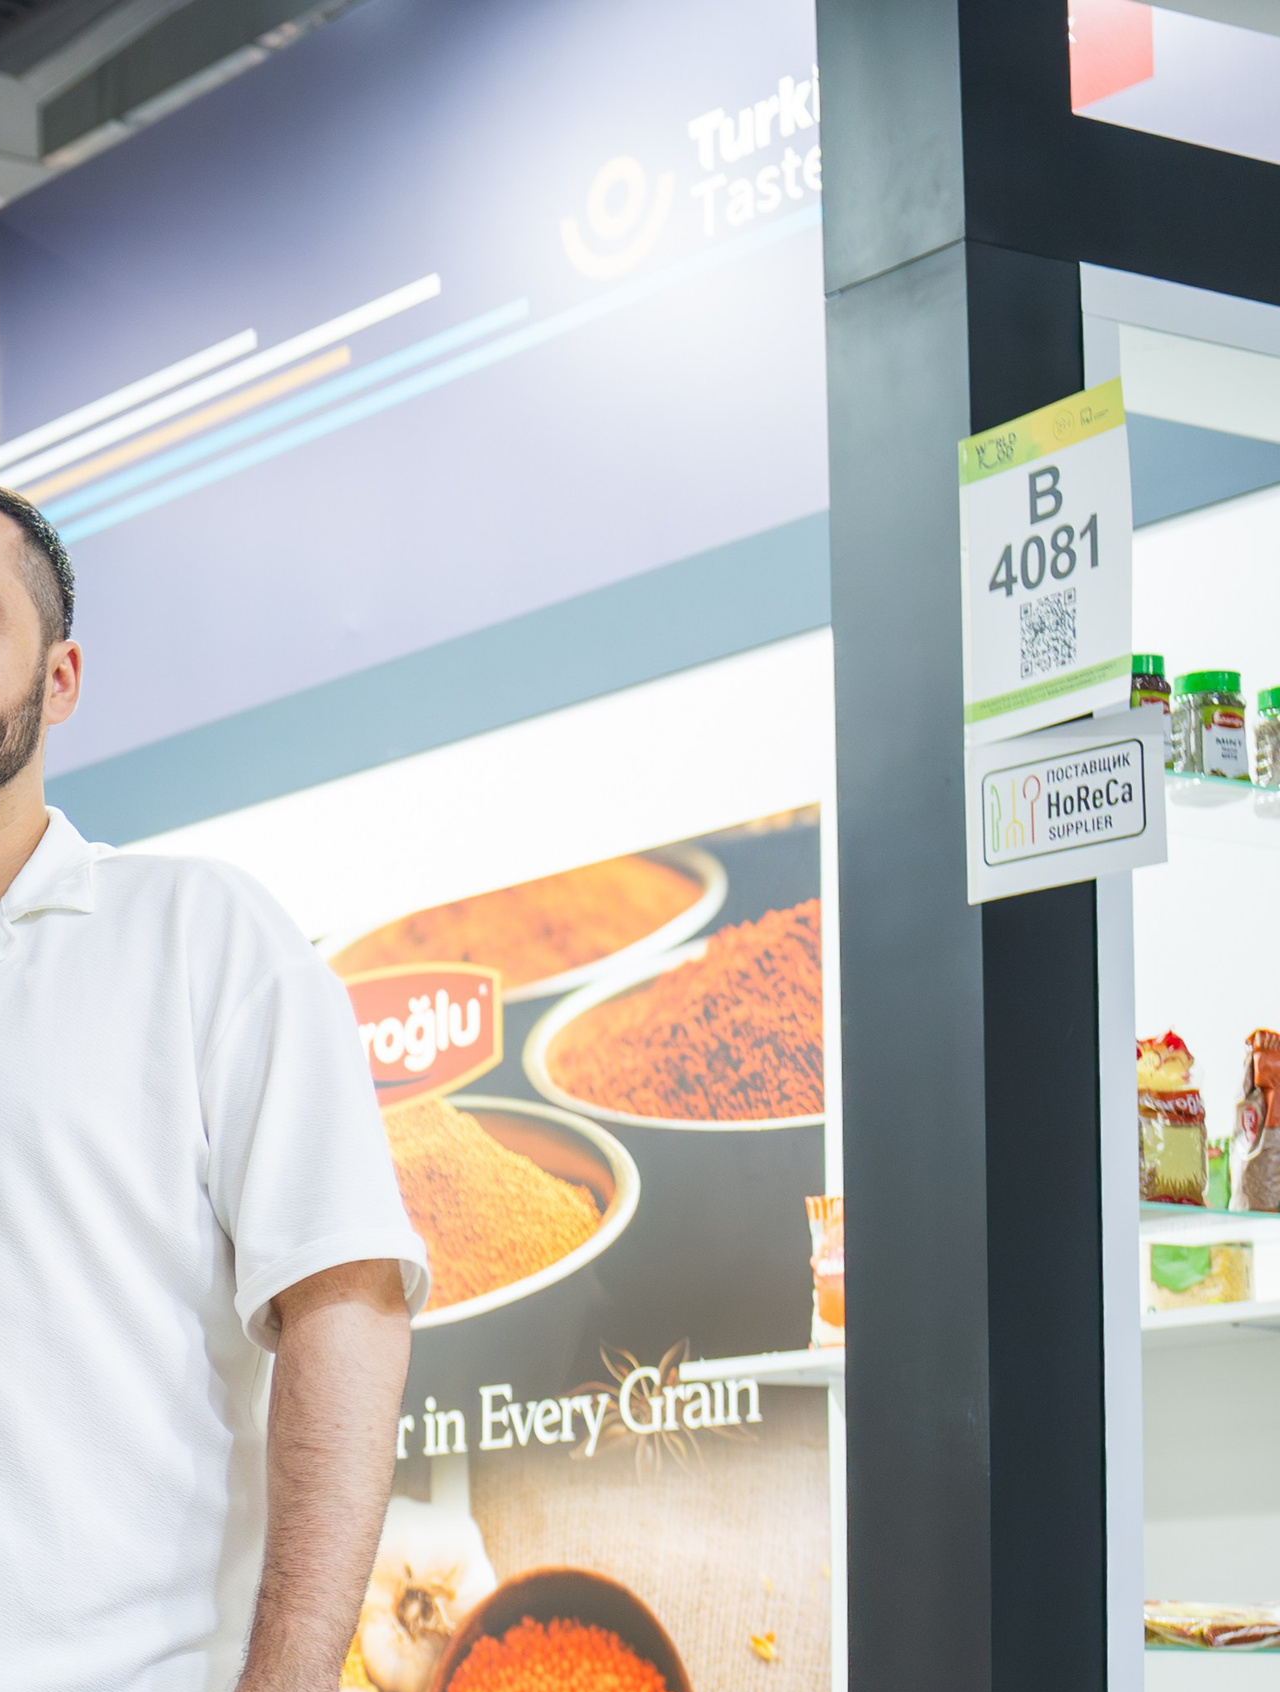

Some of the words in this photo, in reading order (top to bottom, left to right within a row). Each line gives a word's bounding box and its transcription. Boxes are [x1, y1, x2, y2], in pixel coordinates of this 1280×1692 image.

[1028, 465, 1063, 525] B
[989, 514, 1099, 598] 4081
[1046, 752, 1131, 785] ПОСТАВЩИК
[1047, 778, 1133, 819] HoReCa
[1048, 815, 1113, 841] SUPPLIER
[423, 1396, 468, 1456] in
[479, 1384, 611, 1457] Every
[620, 1366, 762, 1434] Grain
